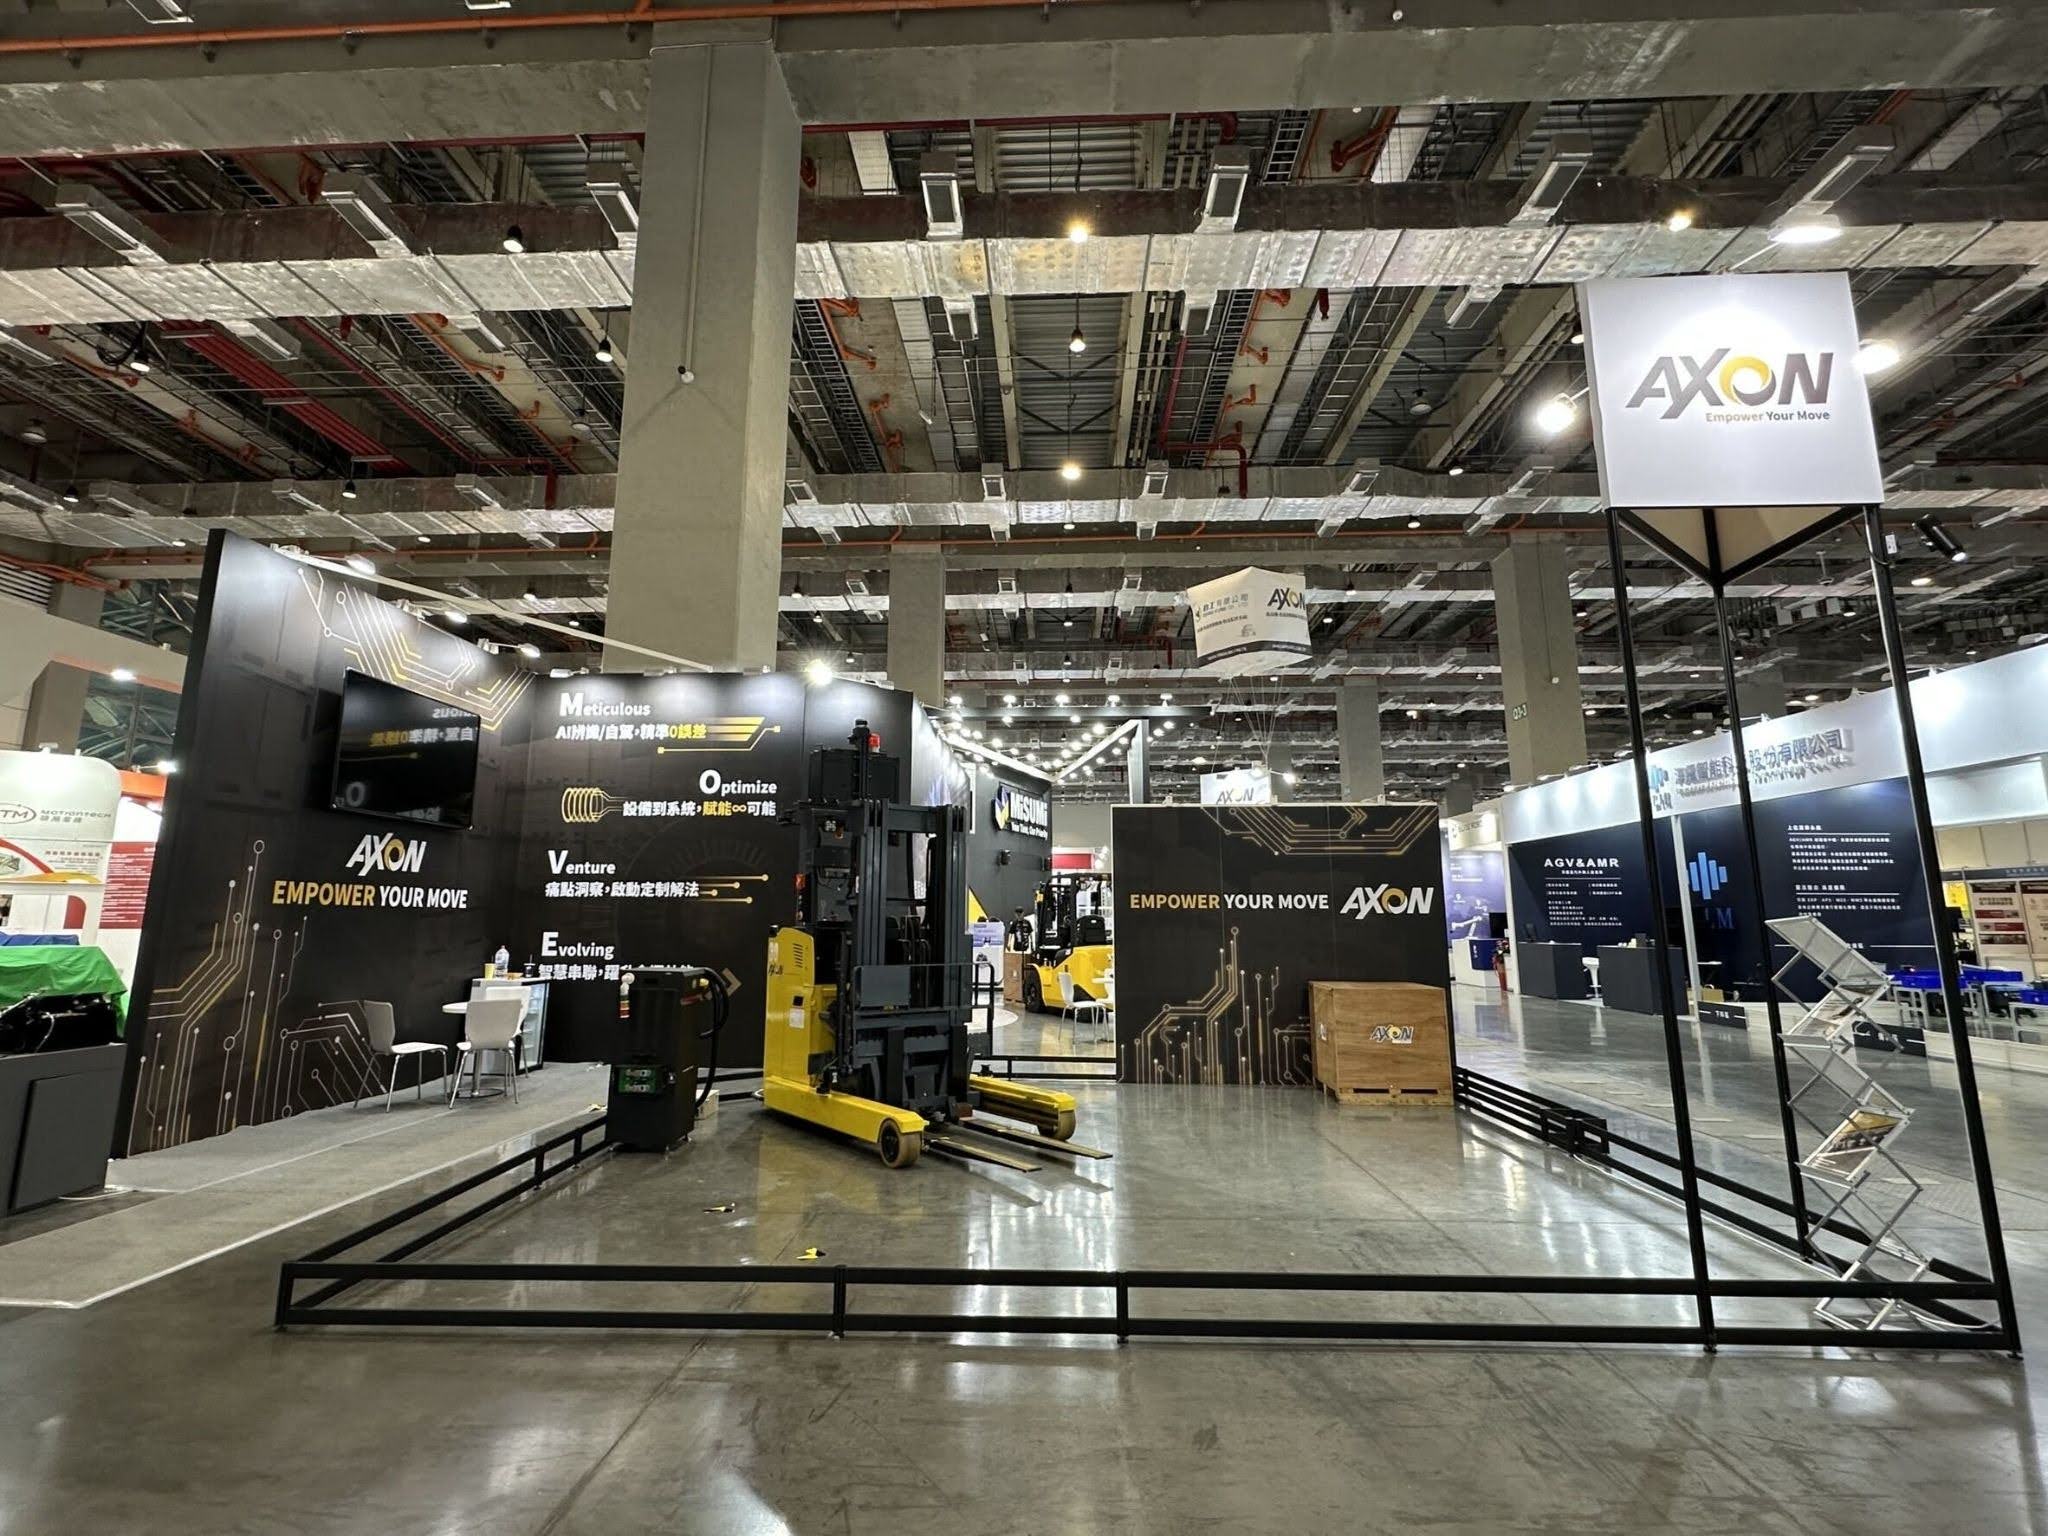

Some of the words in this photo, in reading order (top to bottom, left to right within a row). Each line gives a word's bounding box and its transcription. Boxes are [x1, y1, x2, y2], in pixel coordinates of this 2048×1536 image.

[1625, 348, 1834, 419] AXON
[1706, 412, 1763, 423] Empower
[1766, 411, 1794, 421] Your
[1797, 410, 1830, 420] Move
[560, 692, 651, 717] Meticulous
[699, 769, 777, 797] Optimize
[345, 832, 427, 876] AXON
[548, 850, 616, 875] Venture
[1544, 858, 1619, 868] AGV&AMR
[272, 880, 376, 907] EMPOWER
[379, 885, 423, 908] YOUR
[426, 887, 468, 909] MOVE
[1130, 894, 1220, 910] EMPOWER
[1223, 894, 1274, 910] YOUR
[1278, 894, 1329, 910] MOVE
[1339, 884, 1434, 920] AXON
[541, 931, 615, 960] Evolving
[1370, 1024, 1413, 1043] AXON
